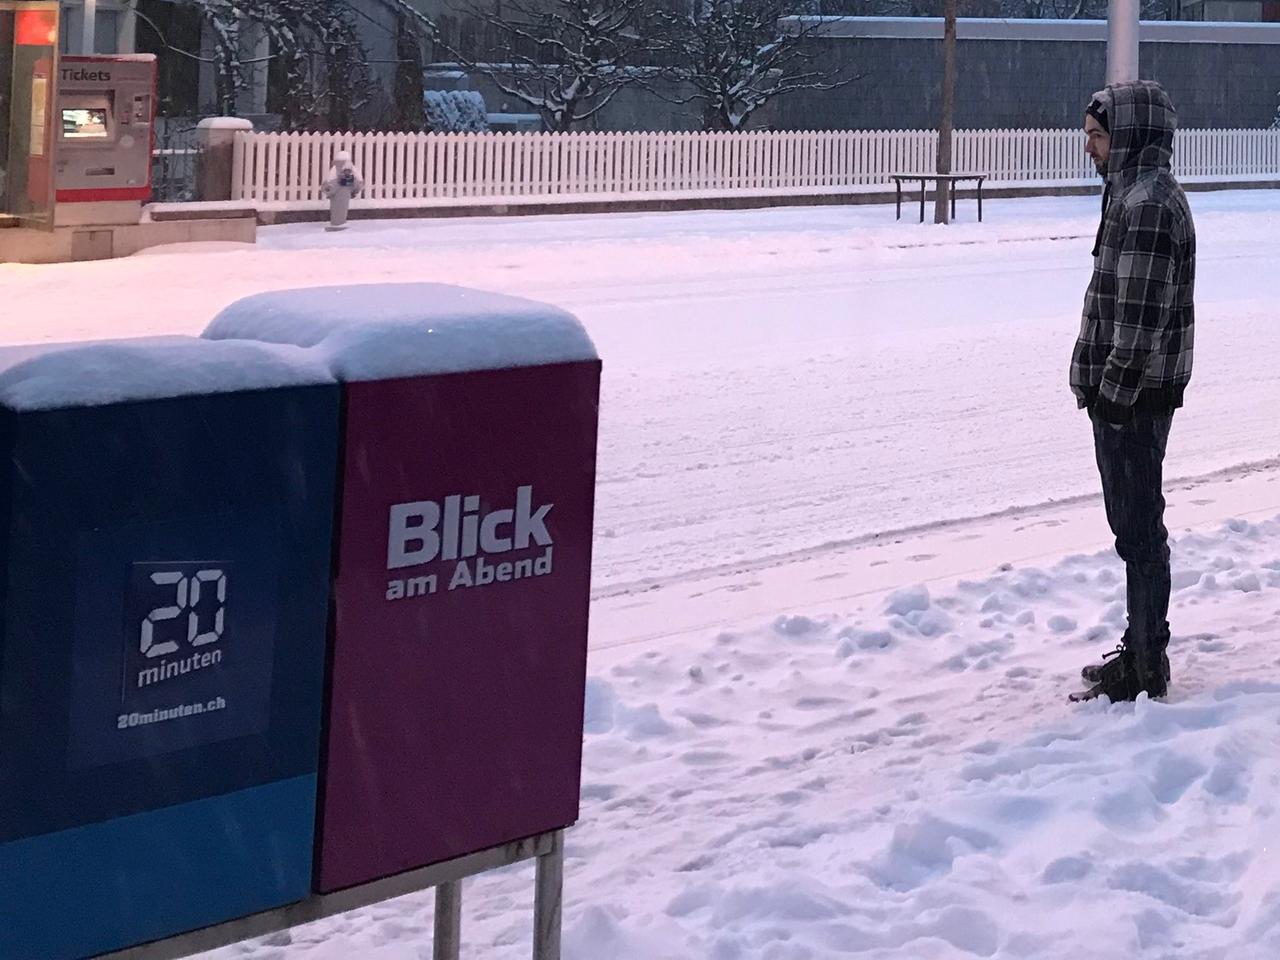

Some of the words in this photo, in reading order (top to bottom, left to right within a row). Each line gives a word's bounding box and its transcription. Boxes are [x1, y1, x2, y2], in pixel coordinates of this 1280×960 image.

[61, 68, 111, 81] Tickets
[387, 485, 554, 570] Blick
[386, 574, 437, 600] am
[448, 546, 553, 590] Abend
[140, 569, 226, 658] 20
[138, 649, 222, 688] minuten
[117, 696, 226, 729] 20minuten.ch
